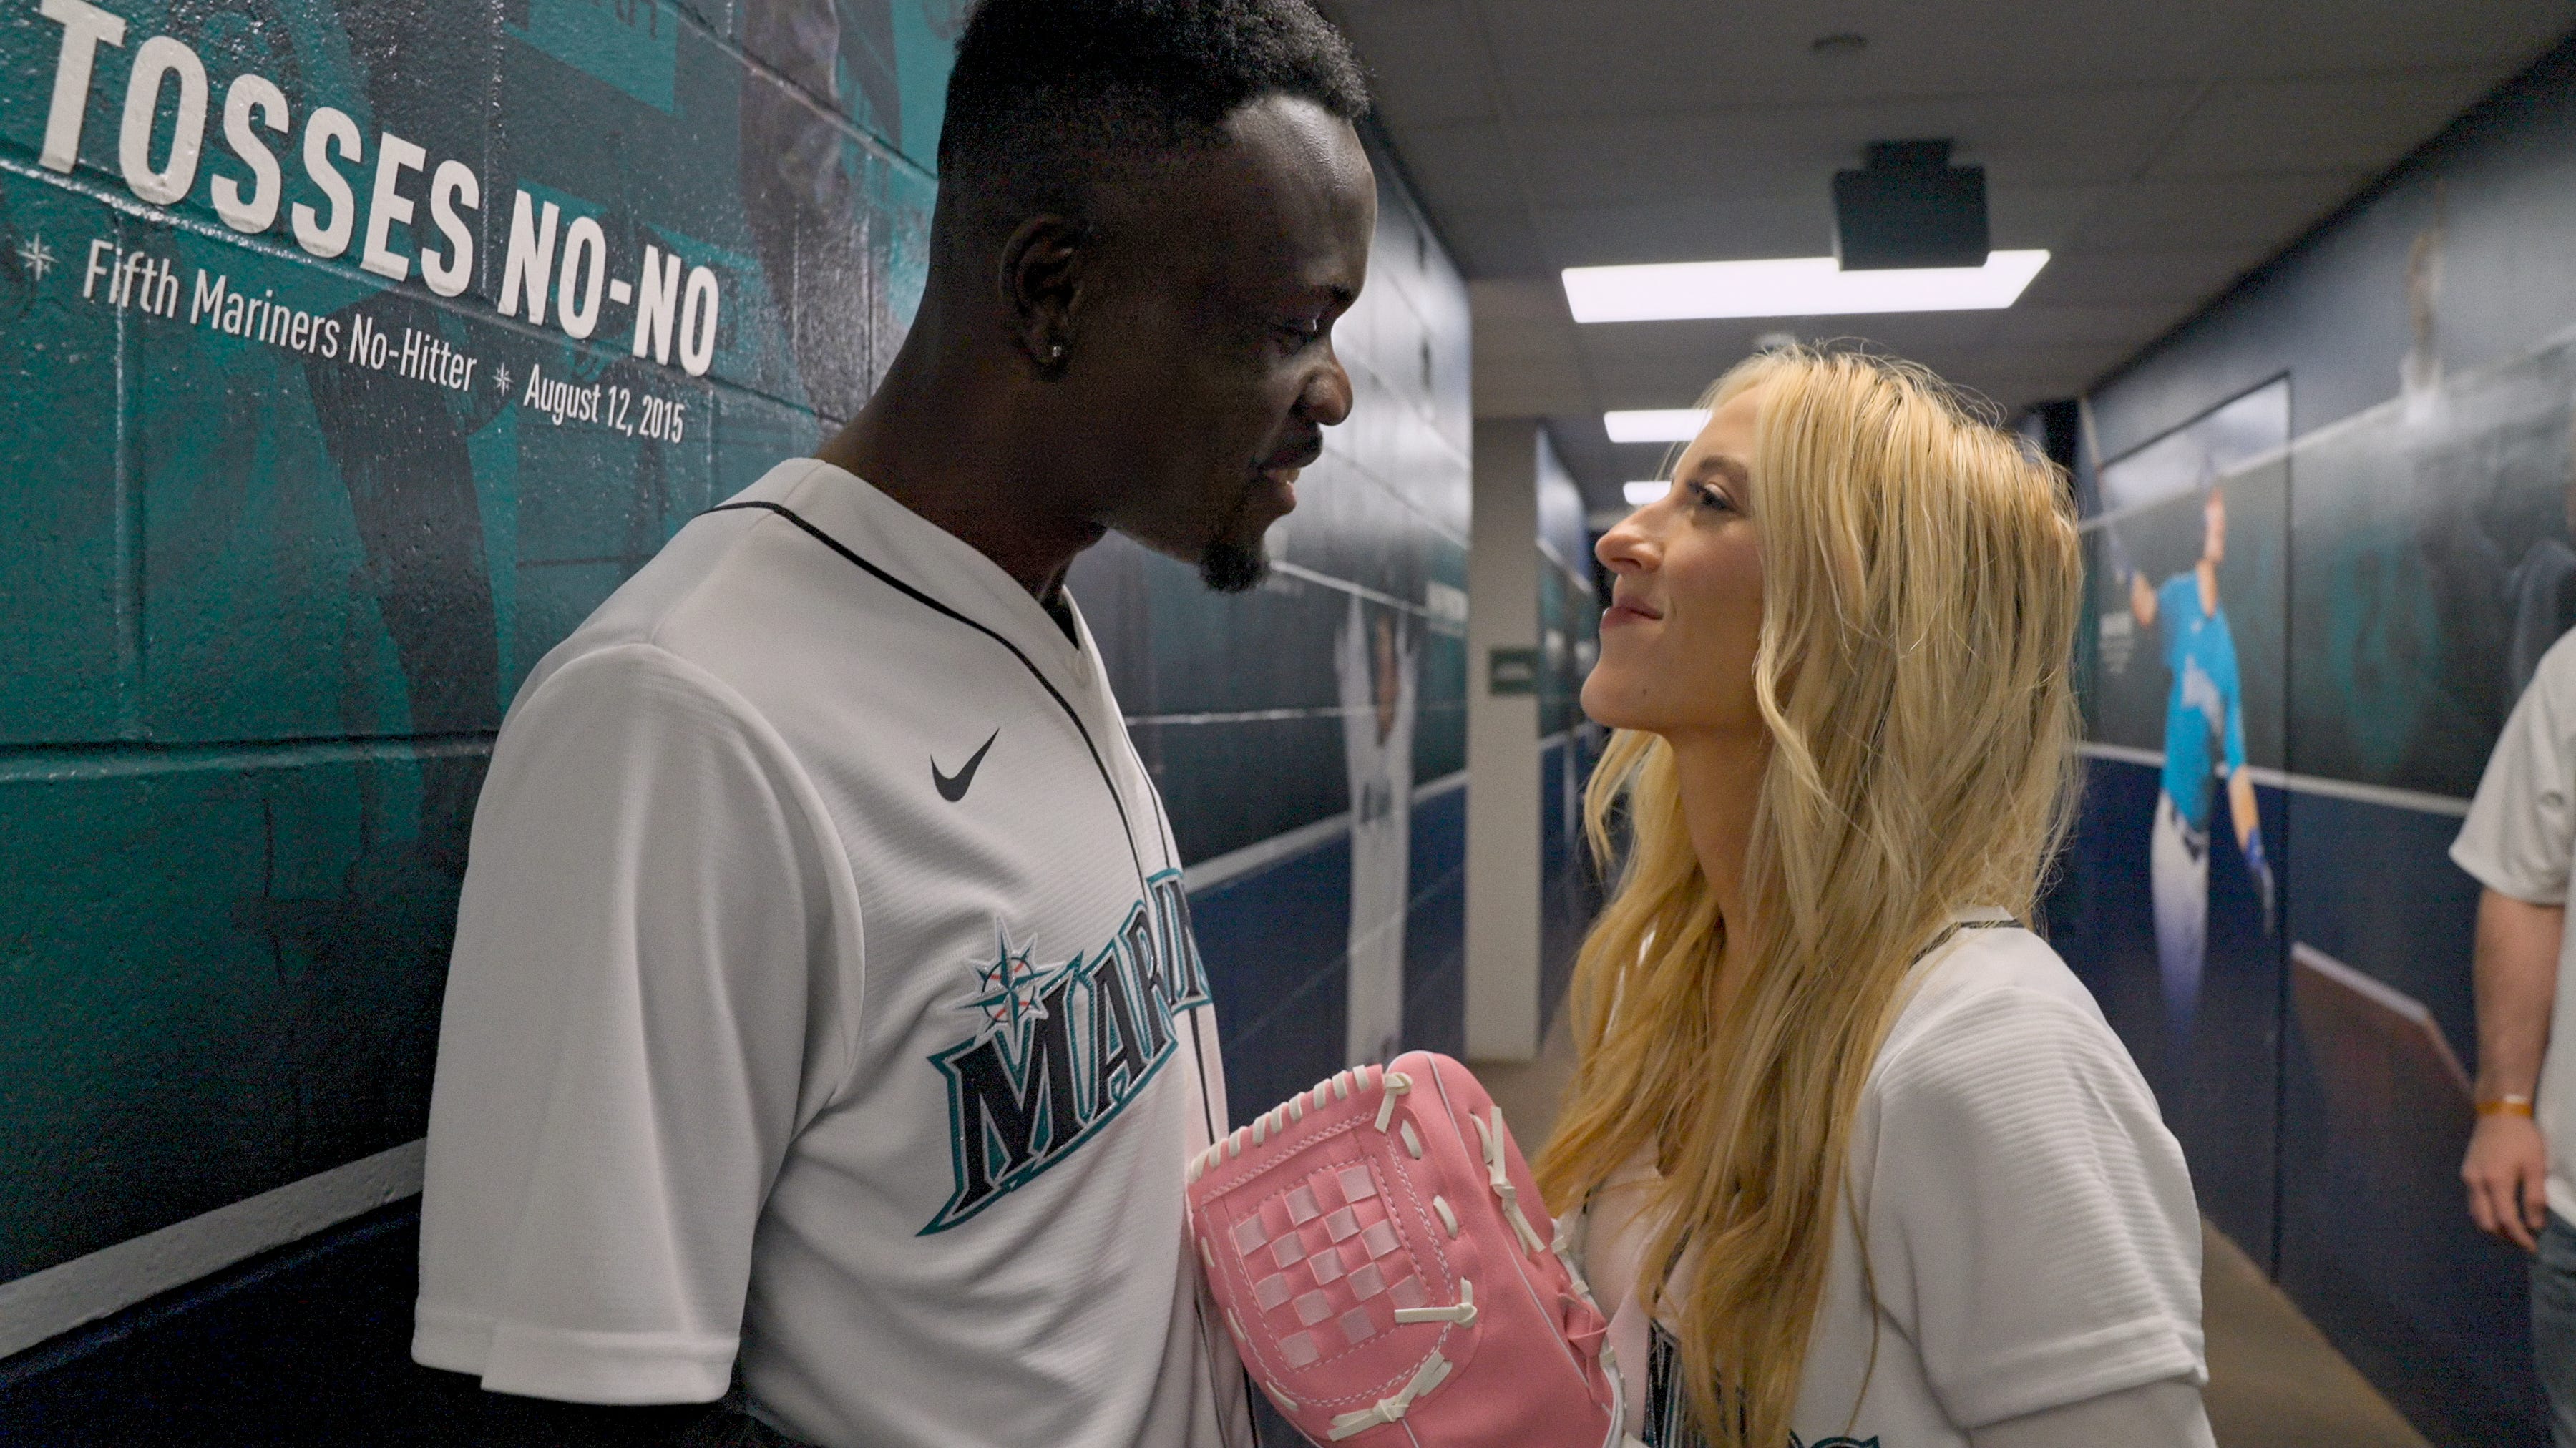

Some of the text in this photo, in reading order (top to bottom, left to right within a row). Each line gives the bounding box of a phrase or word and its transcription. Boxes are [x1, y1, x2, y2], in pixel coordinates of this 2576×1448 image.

[38, 0, 719, 376] TOSSES NO-NO
[82, 238, 686, 444] Fifth Mariners No-Hitter August 12, 2015
